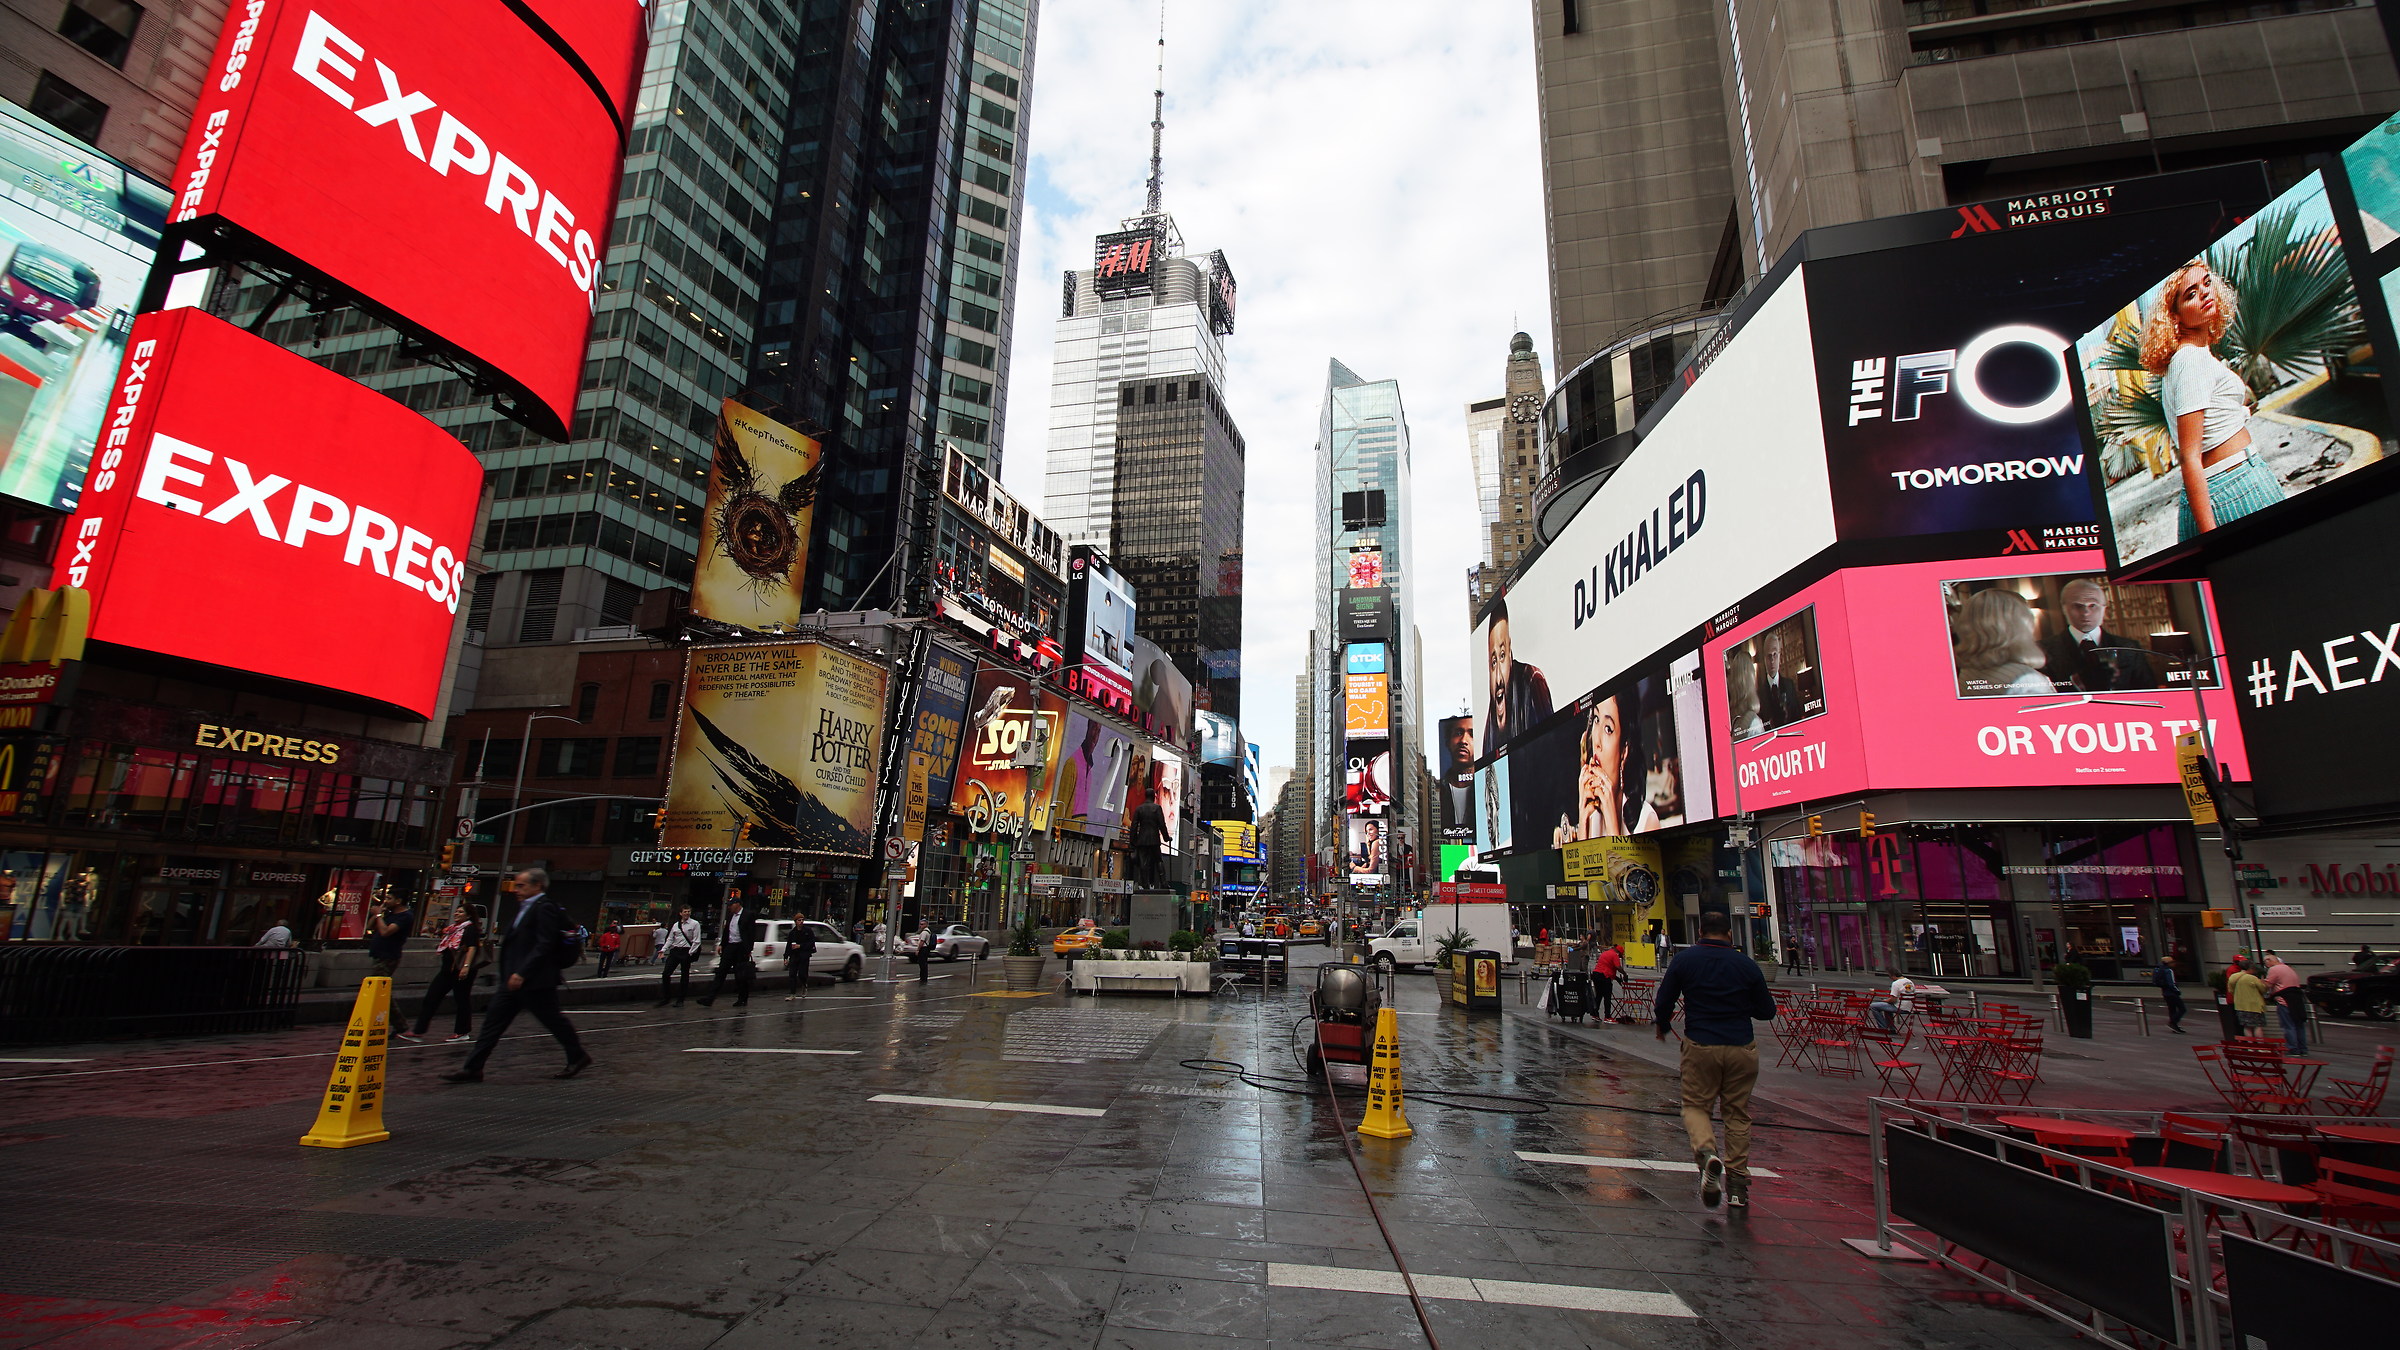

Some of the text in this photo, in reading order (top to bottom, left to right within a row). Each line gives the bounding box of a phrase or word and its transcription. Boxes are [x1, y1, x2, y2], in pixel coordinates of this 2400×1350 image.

[220, 0, 265, 92] PRESS
[292, 9, 603, 317] EXPRESS
[2008, 186, 2115, 212] MARRIOTT
[2010, 202, 2106, 227] MARQUIS
[1097, 239, 1152, 278] H&M
[1697, 319, 1733, 363] MARRIOTT
[1849, 357, 1886, 427] THE
[94, 339, 157, 493] EXPRESS
[734, 418, 810, 460] #KeepTheSecrets
[1891, 454, 2084, 491] TOMORROW
[136, 432, 465, 615] EXPRESS
[962, 486, 1059, 574] MARQUEE FLAGSHIPS
[1574, 468, 1707, 630] DJ KHALED
[1072, 572, 1083, 580] LG
[1349, 596, 1381, 604] LANDMARK
[1715, 604, 1740, 624] MARRIOTT
[1715, 615, 1738, 634] MARQUIS
[772, 649, 798, 659] WILL
[1357, 653, 1383, 662] TDK
[696, 659, 804, 674] NEVER BE THE SAME.
[829, 653, 884, 680] WILDLY THEATRICAL
[830, 664, 874, 686] AND THRILLING
[707, 673, 748, 682] THEATRICAL
[750, 672, 776, 681] MARVEL
[779, 671, 798, 679] THAT
[818, 669, 882, 698] BROADWAY SPECTACLE
[927, 666, 967, 695] BEST MUSICAL
[2166, 670, 2209, 682] NETFIX
[698, 680, 796, 691] REDEFINES THE POSSIBILITIES
[825, 681, 834, 690] THE
[834, 684, 848, 694] SHOW
[2003, 682, 2048, 690] UNFORTUNATE
[830, 691, 842, 701] BOLT
[842, 694, 849, 702] OF
[1068, 669, 1176, 742] BROADWAY
[1804, 699, 1822, 712] NETFLIX
[818, 707, 875, 748] HARRY
[918, 710, 960, 740] COME
[195, 723, 341, 764] EXPRESS
[913, 728, 957, 759] FROM
[1977, 725, 2037, 756] OR
[2040, 721, 2158, 754] YOUR
[810, 732, 874, 773] POTTER
[1739, 741, 1826, 788] OR YOUR TV
[2184, 763, 2200, 772] THE
[816, 768, 866, 787] CURSED CHILD
[911, 781, 923, 792] THE
[908, 790, 924, 805] LION
[905, 807, 925, 824] KING
[1611, 836, 1655, 844] INVICTA
[630, 851, 754, 864] GIFTS LUGGAGE
[1583, 853, 1603, 865] INVICTA
[160, 867, 222, 879] EXPRESS
[252, 871, 307, 883] EXPRESS
[338, 892, 362, 903] SIZES
[339, 1056, 358, 1064] SAFETY
[363, 1055, 384, 1064] SAFETY
[364, 1063, 381, 1071] FIRST
[338, 1065, 353, 1073] FIRST
[339, 1076, 346, 1084] LA
[367, 1075, 374, 1083] LA
